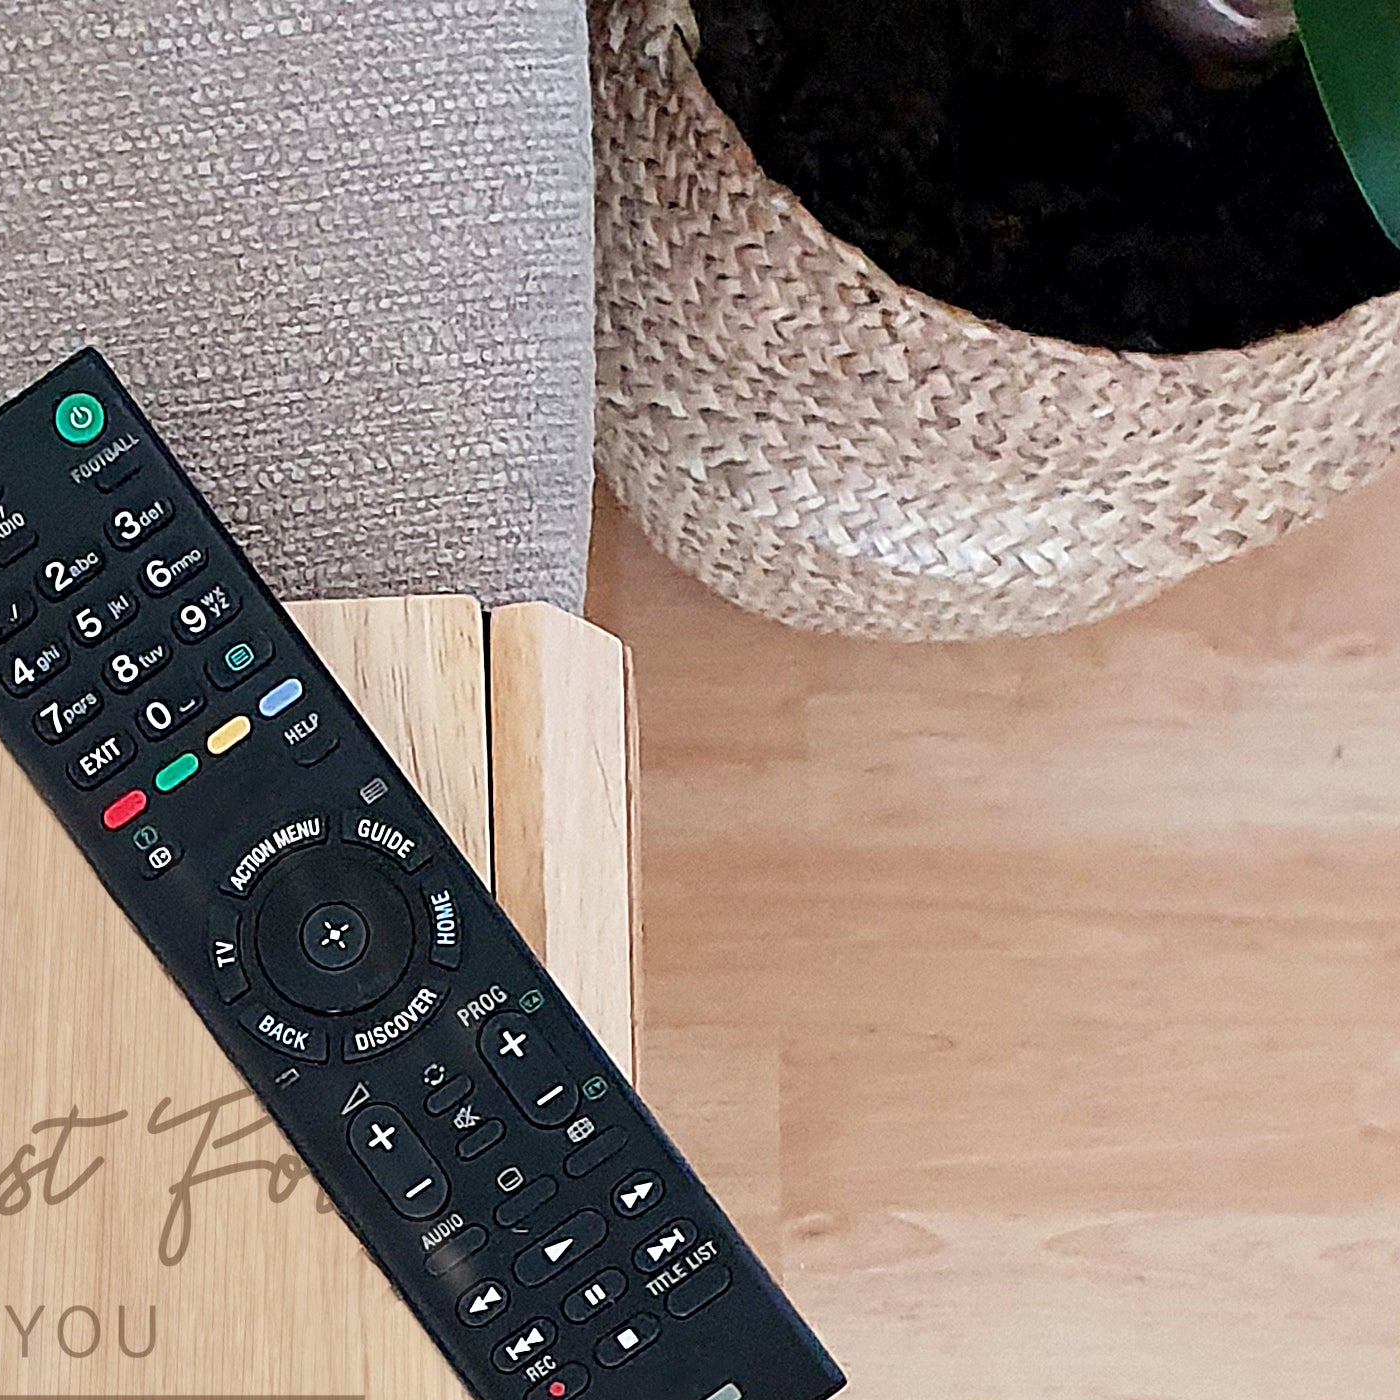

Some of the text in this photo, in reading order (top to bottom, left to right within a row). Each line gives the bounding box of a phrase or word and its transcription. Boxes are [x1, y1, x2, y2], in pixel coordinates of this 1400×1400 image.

[69, 432, 141, 485] FOOTBALL
[113, 511, 142, 540] 3
[44, 560, 74, 592] 2
[146, 558, 173, 588] 6
[75, 607, 103, 638] 5
[180, 604, 208, 634] 9
[13, 656, 36, 685] 4
[111, 653, 140, 683] 8
[39, 701, 64, 734] 7
[145, 701, 173, 730] 0
[283, 712, 320, 746] HELP
[78, 736, 122, 777] EXIT
[230, 817, 323, 892] ACTION MENU
[356, 819, 416, 860] GUIDE
[430, 889, 456, 946] HOME
[215, 941, 237, 968] TV
[354, 987, 439, 1052] DISCOVER
[456, 984, 509, 1028] PROG
[257, 1013, 311, 1051] BACK
[420, 1213, 465, 1251] AUDIO
[645, 1240, 719, 1297] TITLE LIST
[4, 1304, 159, 1359] YOU
[524, 1354, 558, 1383] REC
